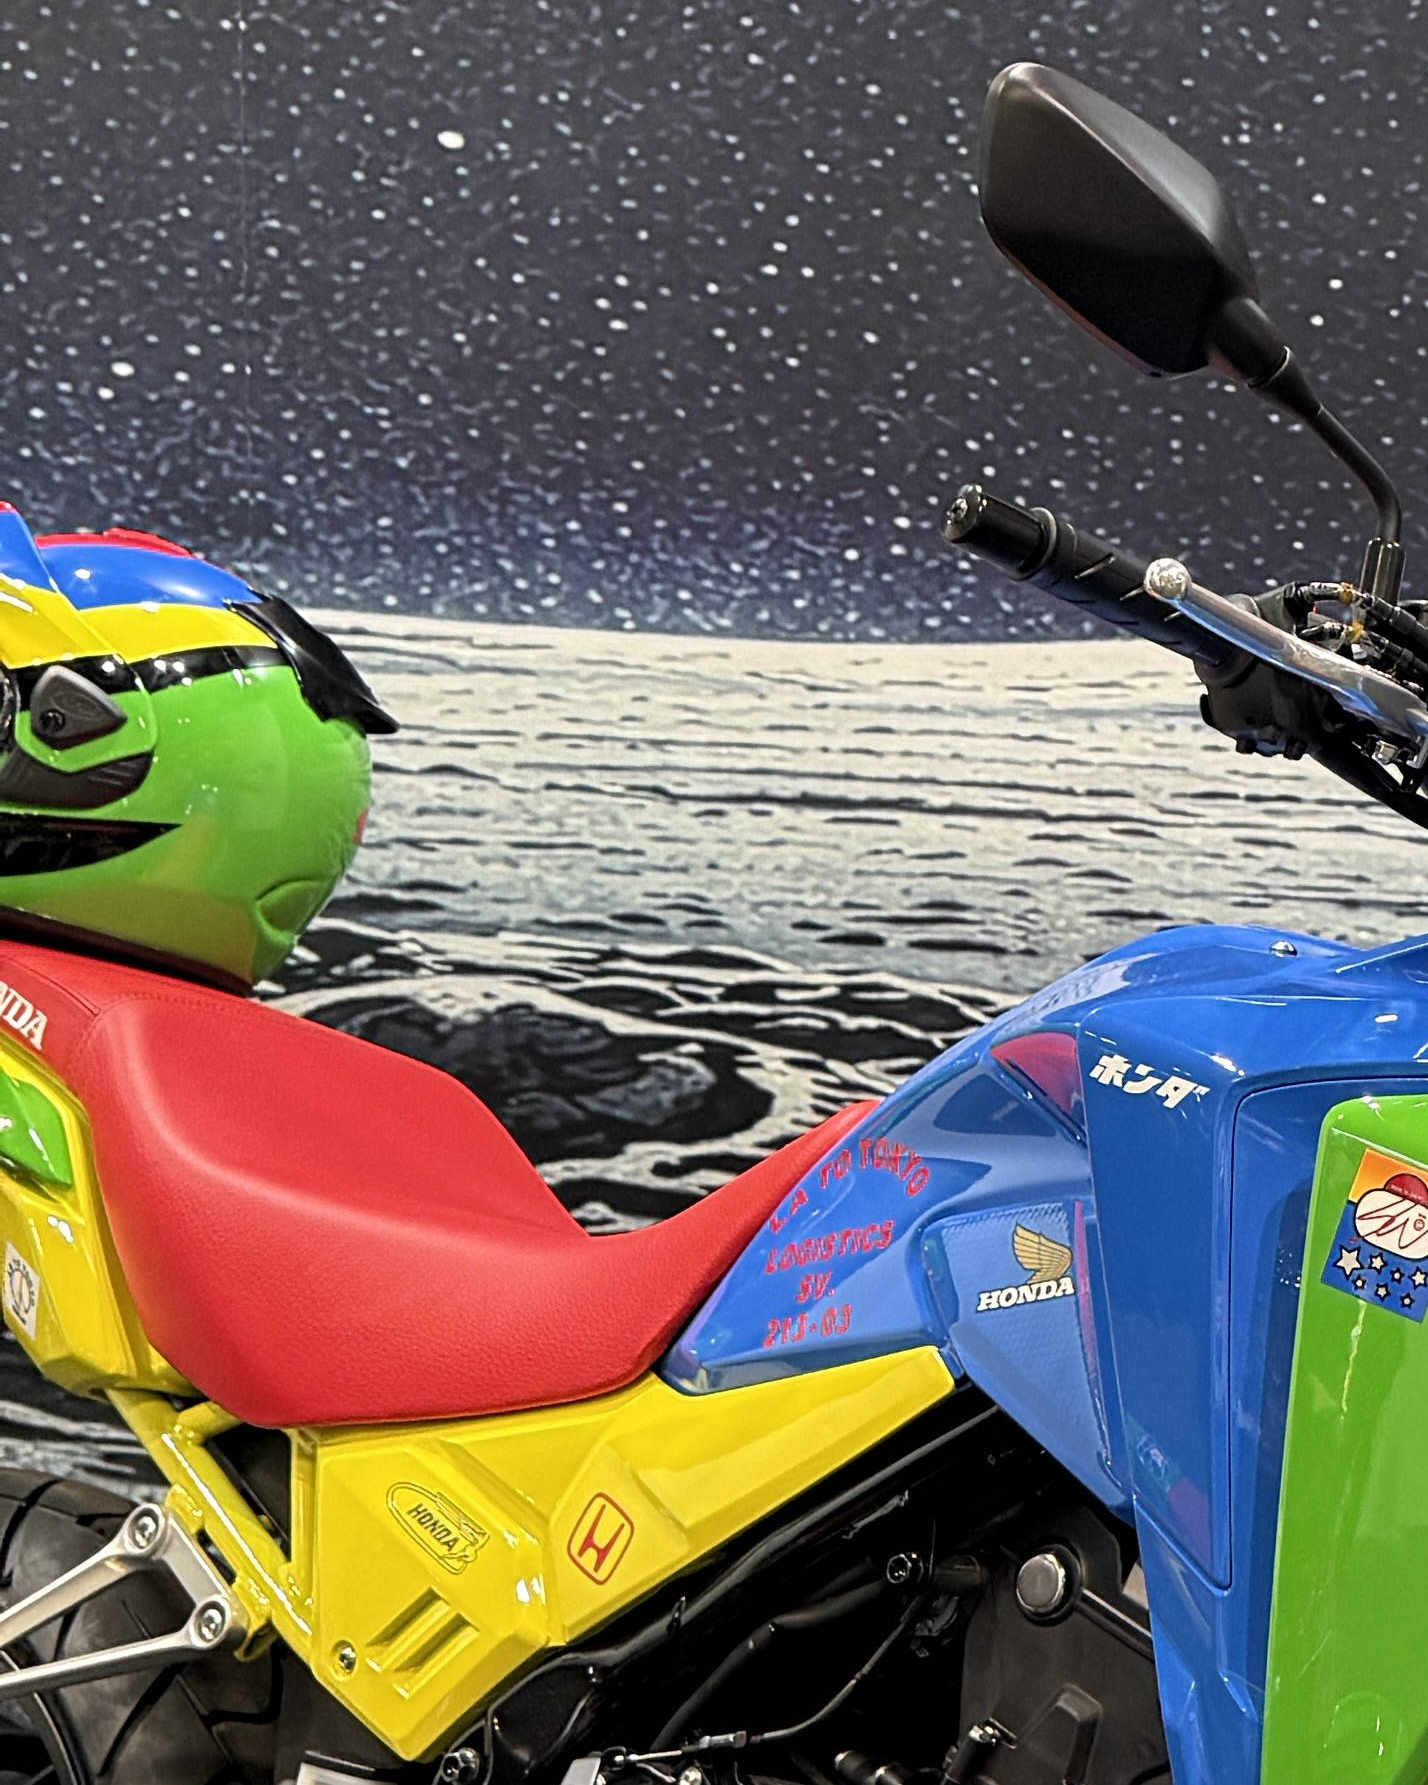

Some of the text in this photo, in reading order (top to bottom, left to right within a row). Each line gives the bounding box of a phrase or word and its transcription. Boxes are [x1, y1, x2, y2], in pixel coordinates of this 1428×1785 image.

[1089, 1053, 1210, 1111] ホンダ
[769, 1136, 931, 1234] LA TO TOKYO
[764, 1219, 895, 1274] LOGISTICS
[975, 1275, 1075, 1314] HONDA
[407, 1502, 460, 1552] HONDA
